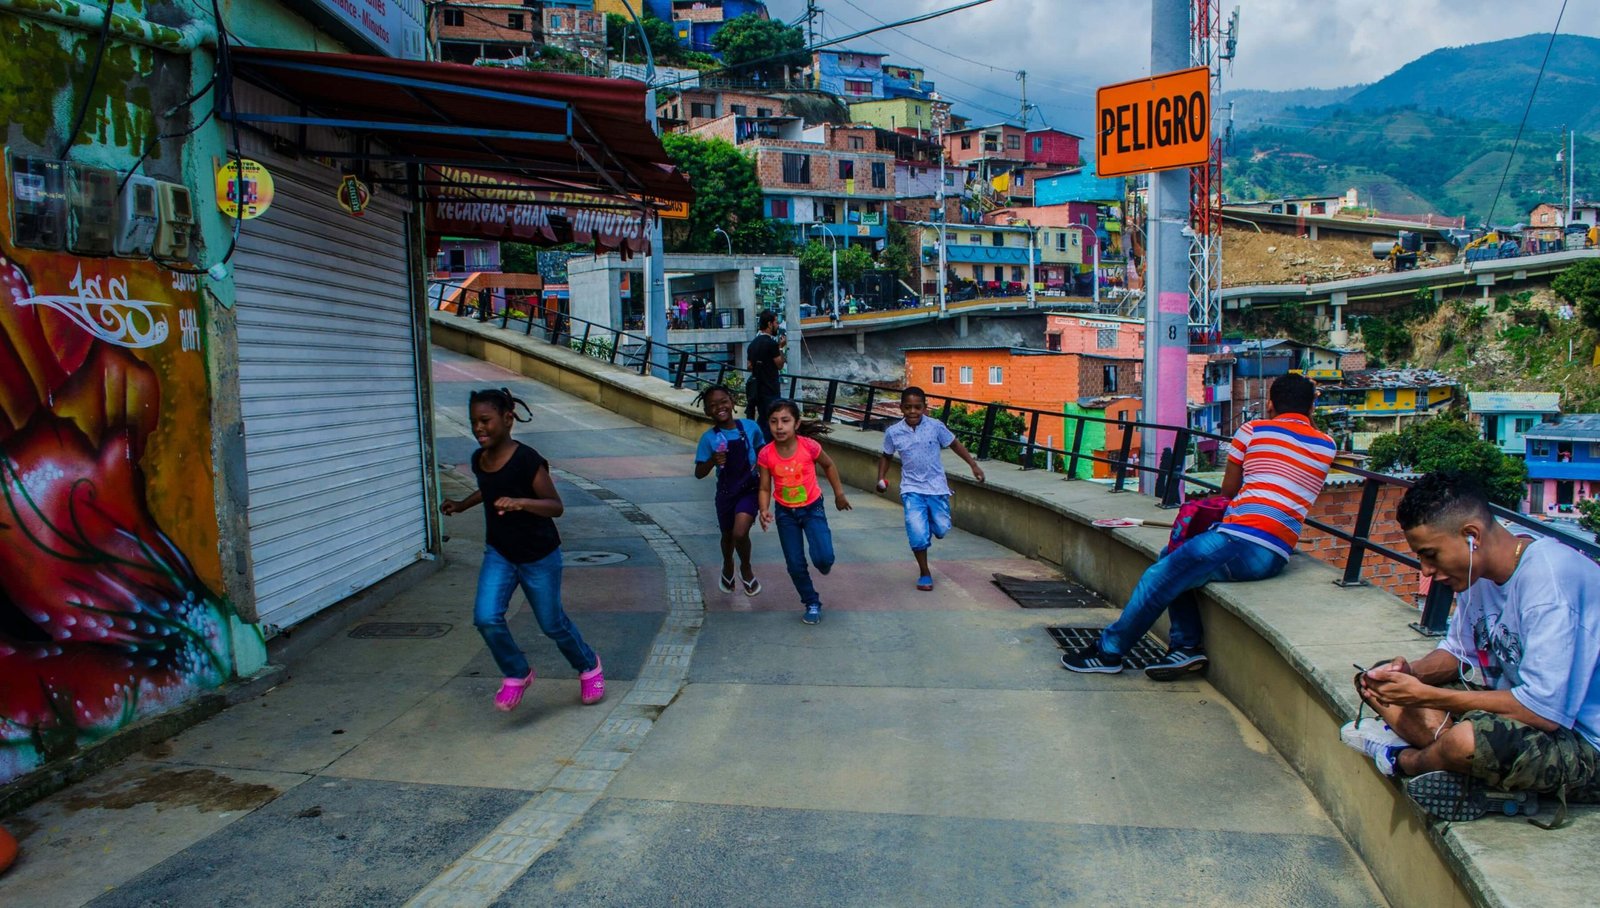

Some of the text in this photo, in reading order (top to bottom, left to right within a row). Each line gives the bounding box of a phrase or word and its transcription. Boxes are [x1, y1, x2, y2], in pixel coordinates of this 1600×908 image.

[362, 9, 390, 43] Minutos
[1101, 91, 1206, 156] PELIGRO
[347, 179, 361, 212] REDD'S
[574, 208, 642, 239] MINUTOS
[1168, 325, 1177, 340] 8
